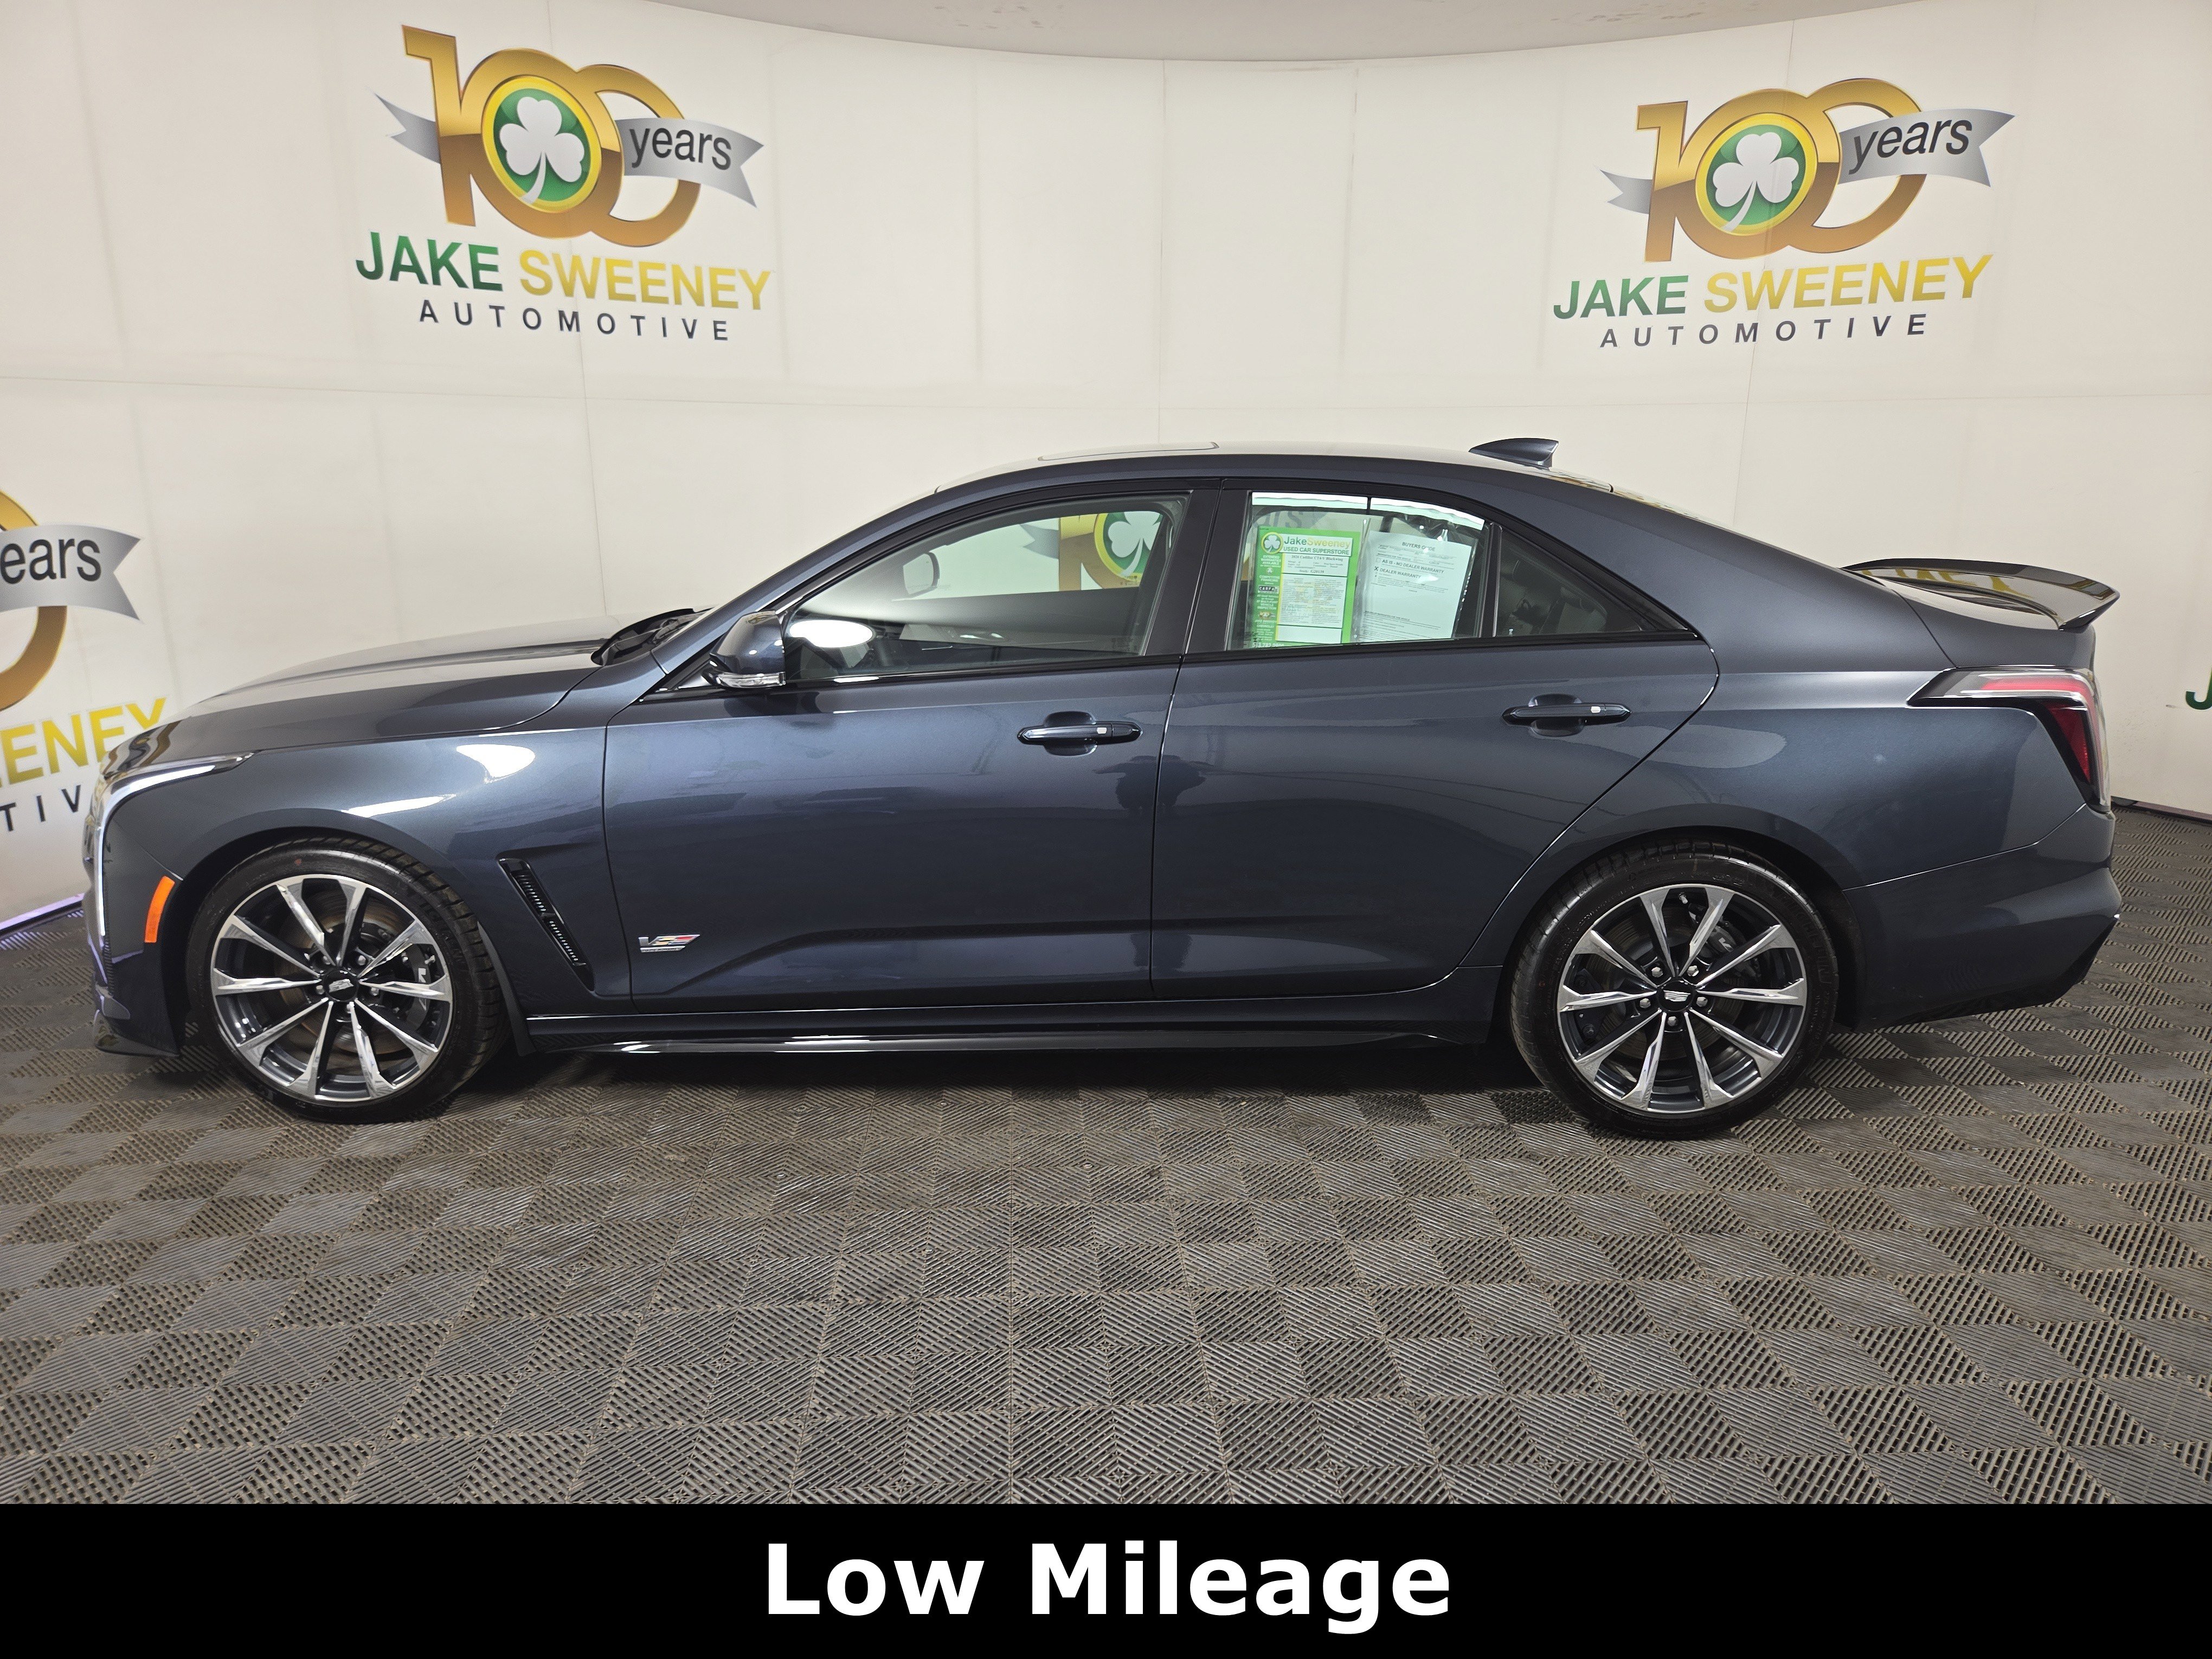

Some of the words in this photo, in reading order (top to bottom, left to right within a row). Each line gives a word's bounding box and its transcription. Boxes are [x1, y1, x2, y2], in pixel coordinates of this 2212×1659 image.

[629, 127, 732, 171] years
[1848, 118, 1972, 175] years
[355, 231, 504, 292] JAKE
[519, 249, 771, 310] SWEENEY
[1554, 275, 1689, 320] JAKE
[1704, 254, 1994, 314] SWEENEY
[419, 299, 728, 341] AUTOMOTIVE
[1600, 313, 1927, 348] AUTOMOTIVE
[0, 697, 165, 788] ENEY
